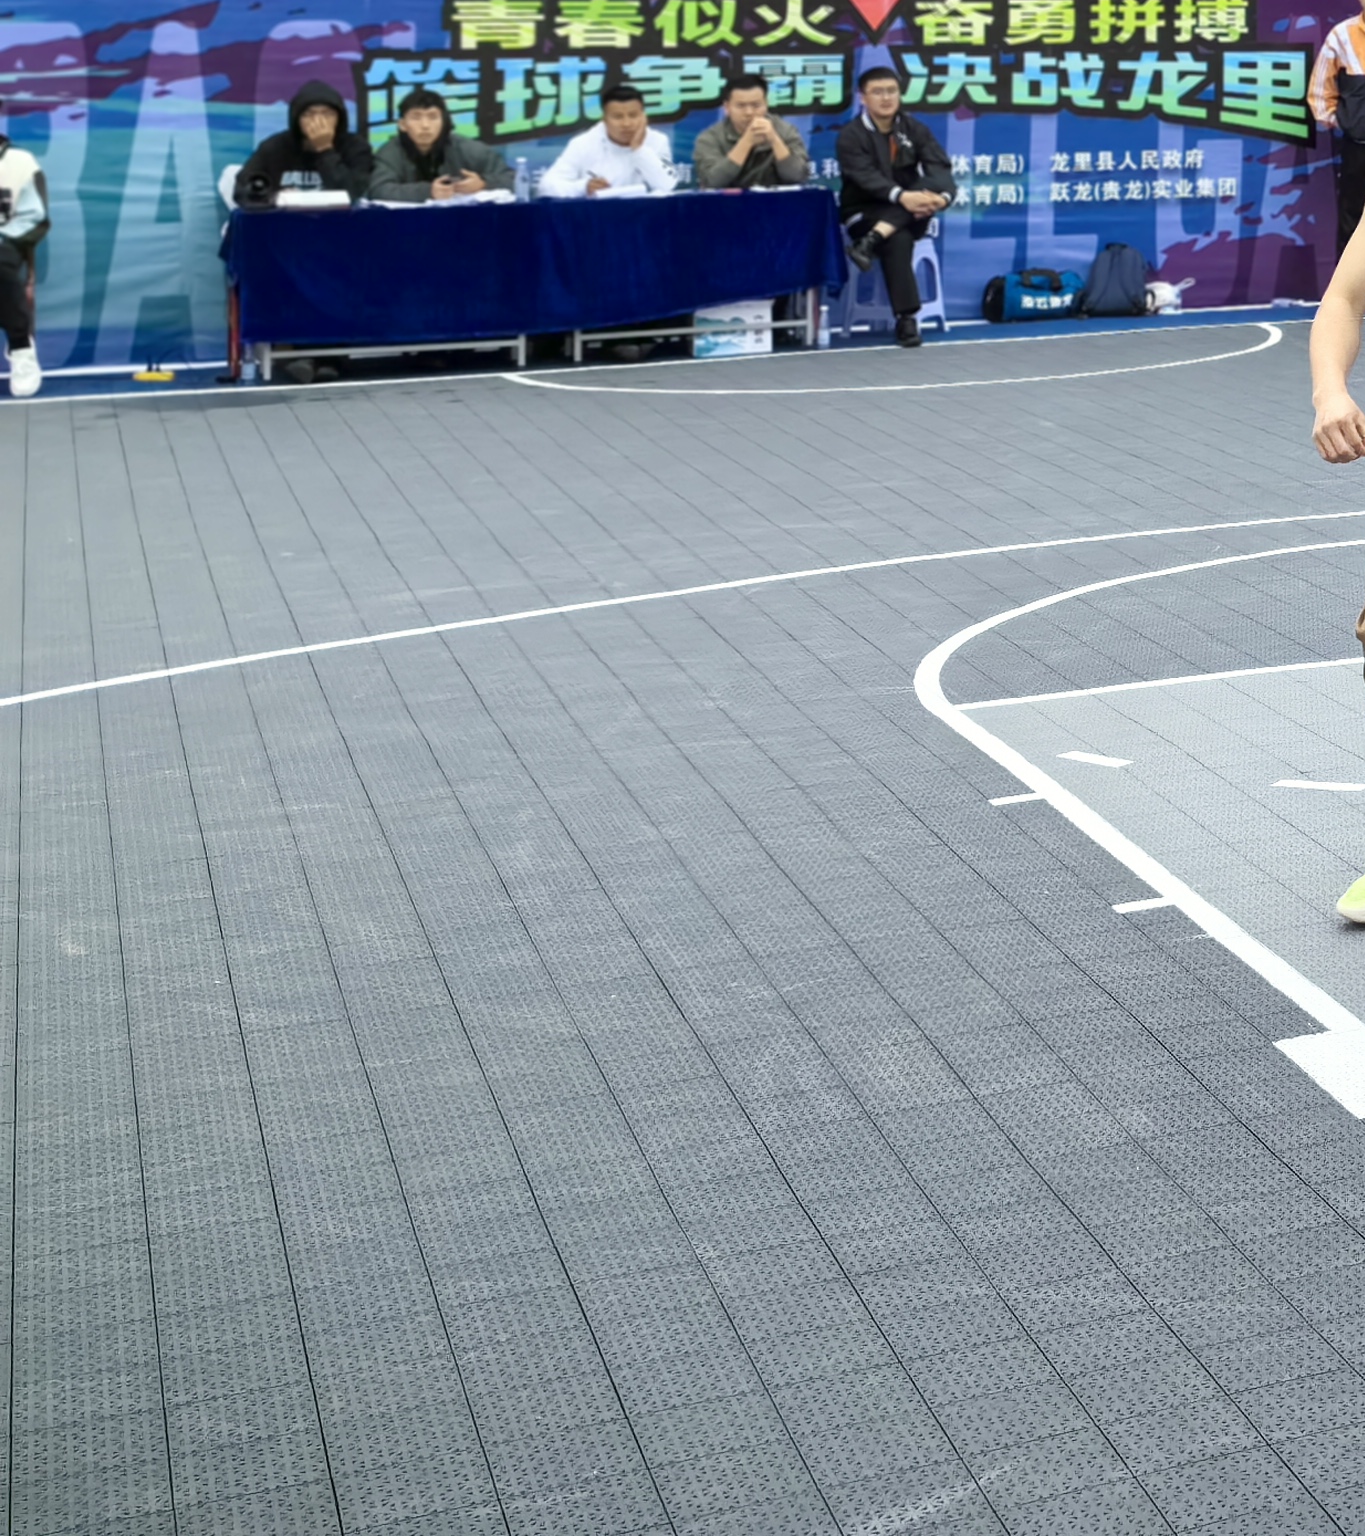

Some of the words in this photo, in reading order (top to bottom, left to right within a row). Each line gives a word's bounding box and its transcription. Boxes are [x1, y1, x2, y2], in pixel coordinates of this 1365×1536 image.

[900, 49, 1310, 139] 决战龙里
[1050, 148, 1205, 172] 龙里县人民政府
